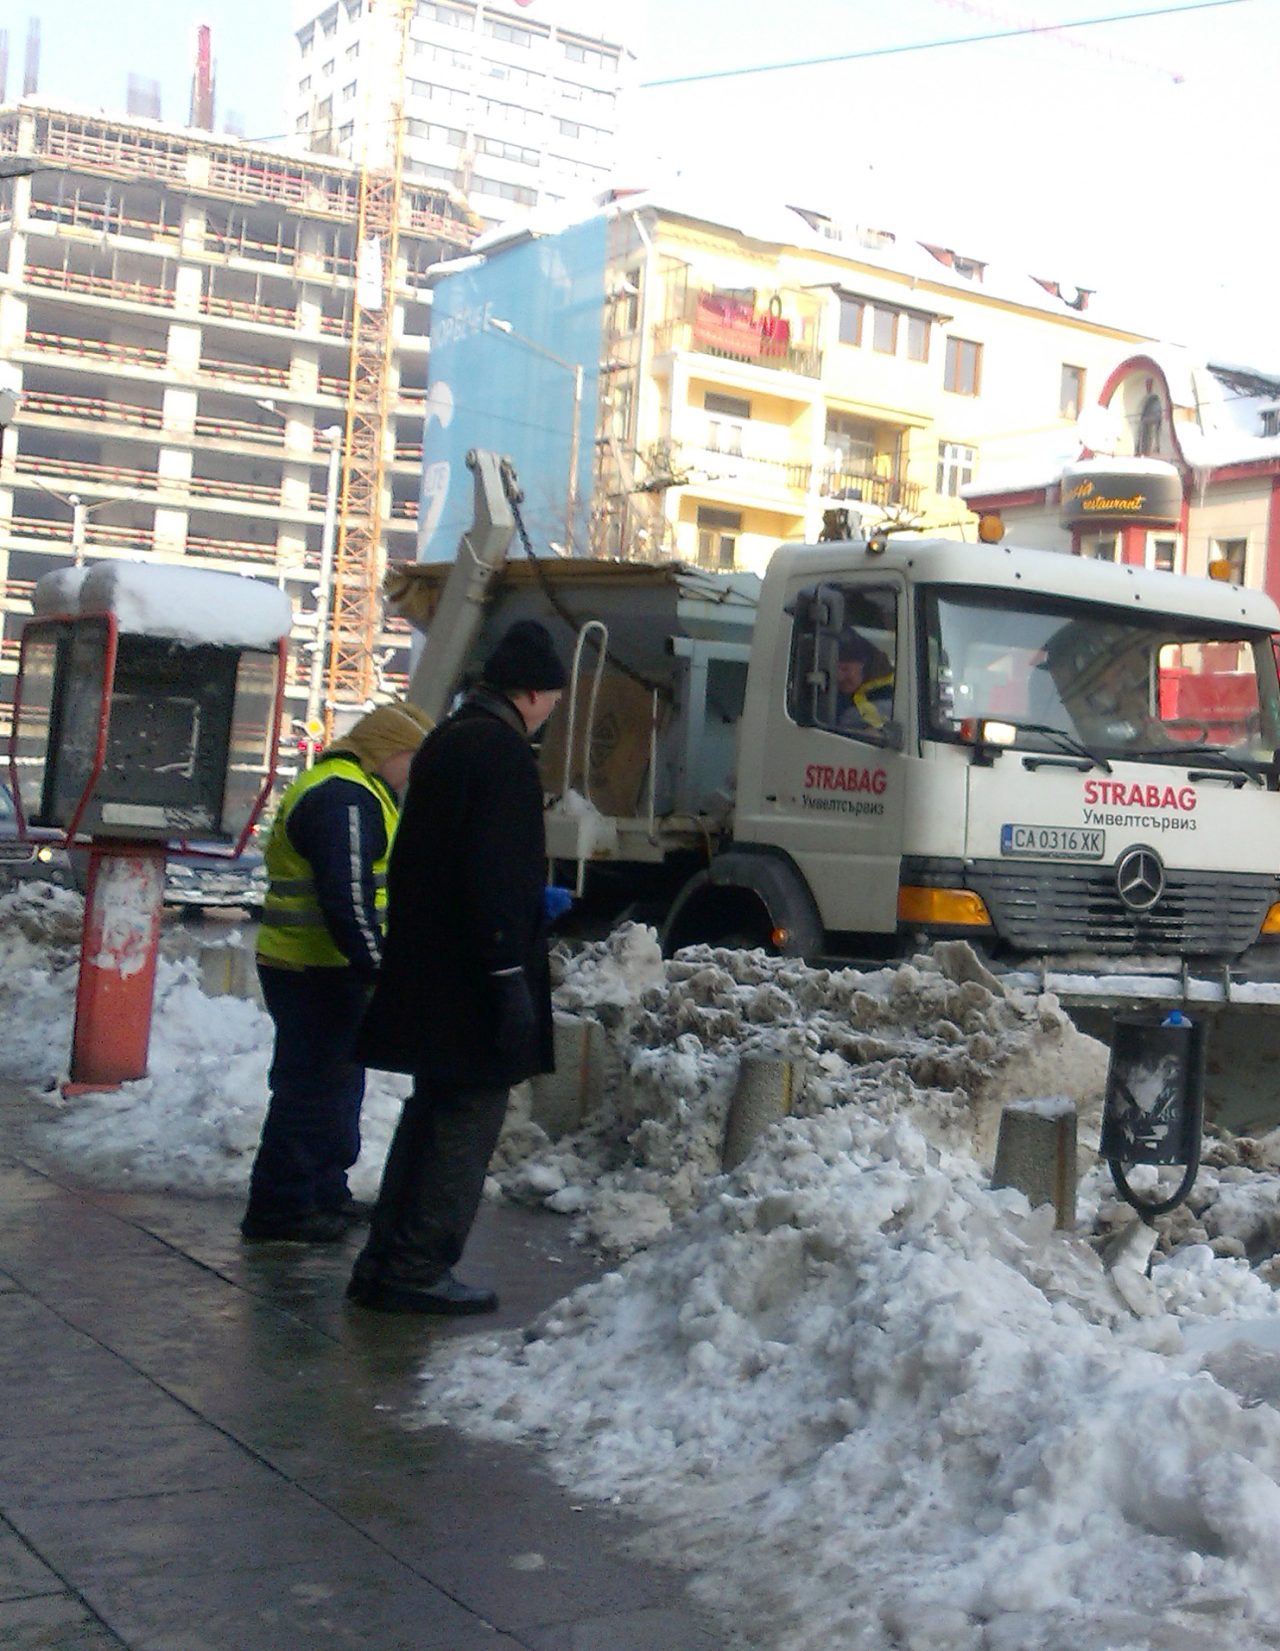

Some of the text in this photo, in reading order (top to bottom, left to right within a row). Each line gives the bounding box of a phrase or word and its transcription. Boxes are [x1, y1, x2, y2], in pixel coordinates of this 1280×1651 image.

[804, 765, 887, 795] STRABAG
[802, 793, 884, 816] Умвелтсървиз
[1084, 779, 1197, 811] STRABAG
[1083, 808, 1197, 832] Умвелтсървиз
[1015, 829, 1100, 851] CA 0316 XK
